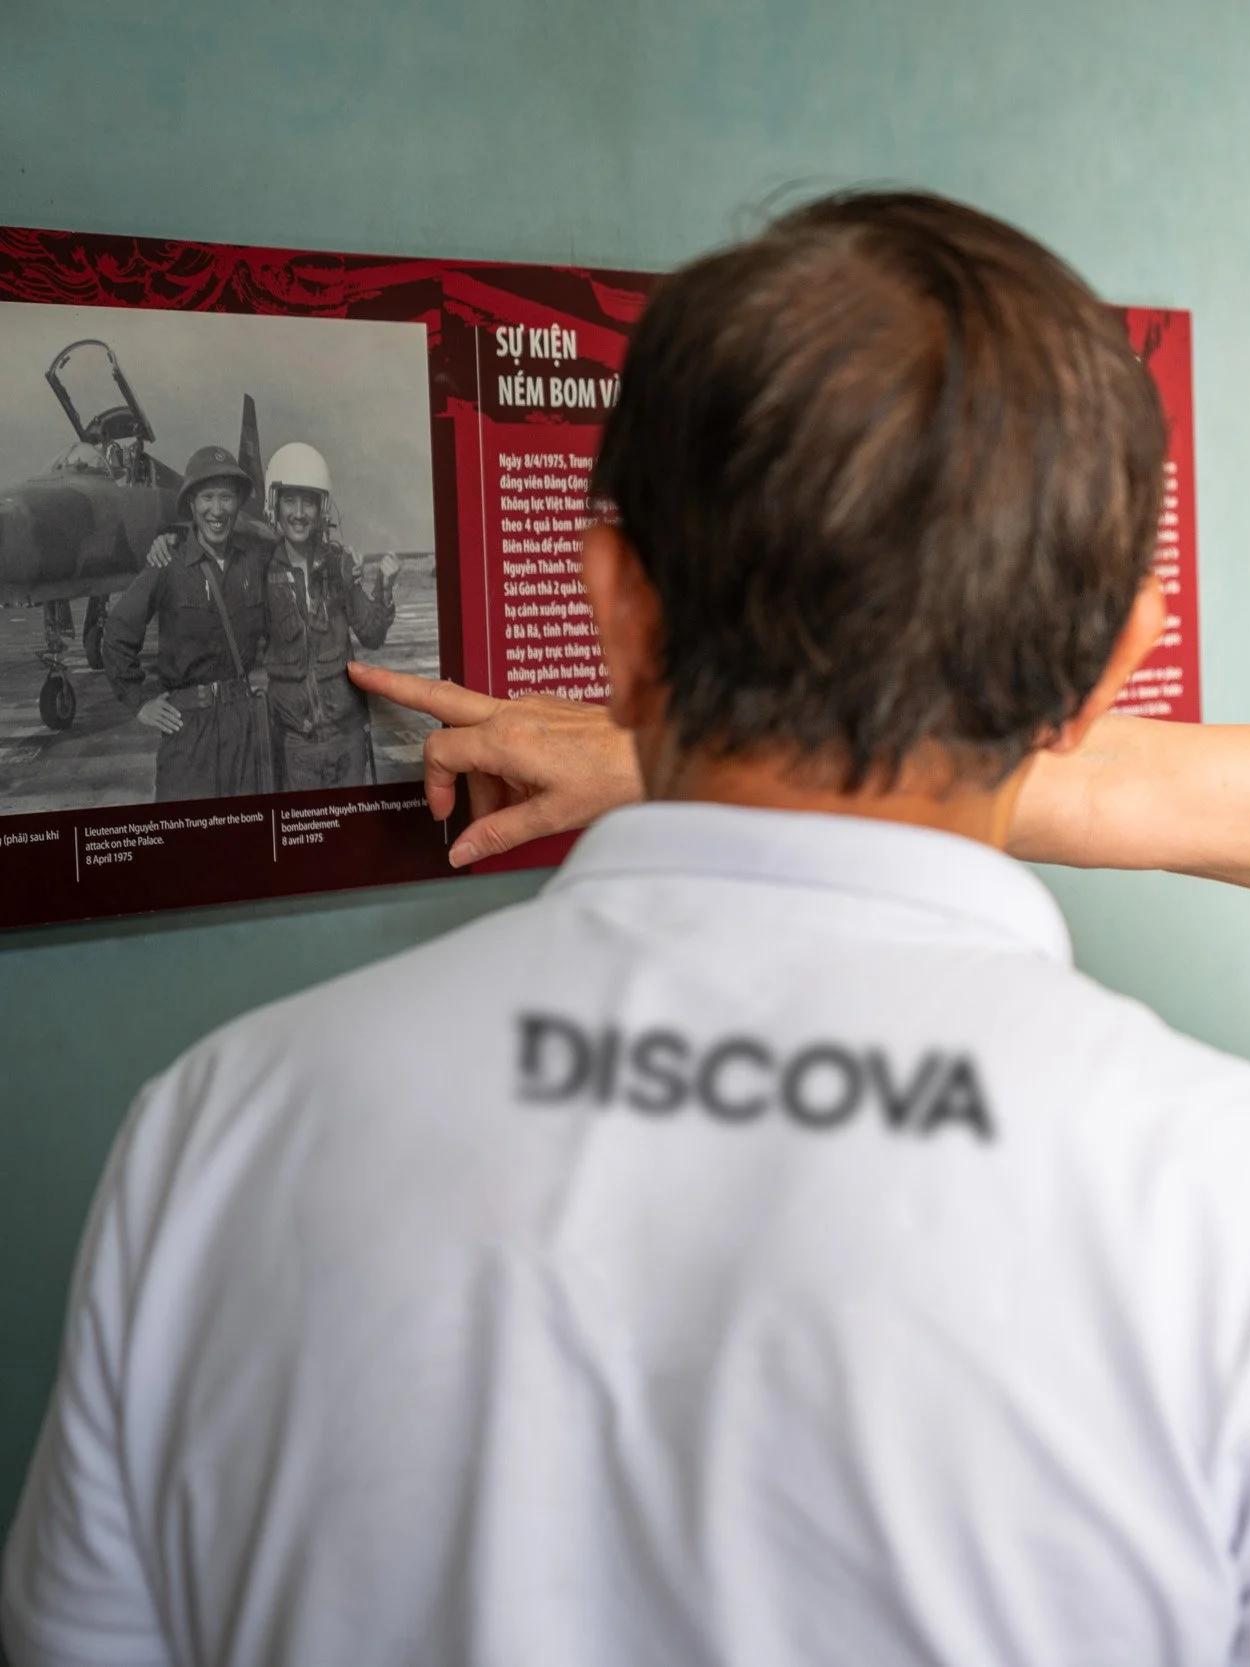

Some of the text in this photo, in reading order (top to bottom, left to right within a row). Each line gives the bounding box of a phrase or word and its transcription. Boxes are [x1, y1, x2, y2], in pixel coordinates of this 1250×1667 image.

[496, 322, 577, 367] SỰ KIỆN
[498, 370, 545, 407] NÉM
[550, 376, 596, 408] BOM
[499, 453, 593, 472] Ngày 8/4/1975, Trung
[501, 496, 529, 514] Không
[546, 495, 563, 513] Việt
[565, 496, 584, 510] Nam
[501, 518, 522, 532] theo
[525, 518, 531, 532] 4
[552, 517, 572, 532] bom
[502, 538, 522, 554] Biên
[523, 538, 541, 553] Hòa
[538, 559, 565, 574] Thành
[504, 581, 518, 596] Sài
[519, 581, 536, 596] Gòn
[554, 580, 560, 595] 2
[517, 602, 539, 617] cánh
[506, 645, 525, 663] máy
[527, 644, 543, 662] bay
[281, 810, 290, 820] Le
[291, 807, 328, 819] lieutenant
[358, 801, 380, 812] Thành
[381, 800, 401, 812] Trung
[85, 826, 127, 837] Lieutenant
[160, 819, 184, 830] Thành
[185, 818, 207, 829] Trung
[207, 815, 226, 826] after
[227, 814, 240, 823] the
[241, 812, 263, 823] bomb
[281, 819, 340, 832] bombardement.
[30, 833, 45, 842] sau
[46, 830, 60, 840] khi
[85, 835, 164, 851] attack on the Palace.
[282, 833, 323, 846] 8 avril 1975
[86, 852, 133, 866] 8 April 1975
[513, 1010, 998, 1148] DISCOVA
